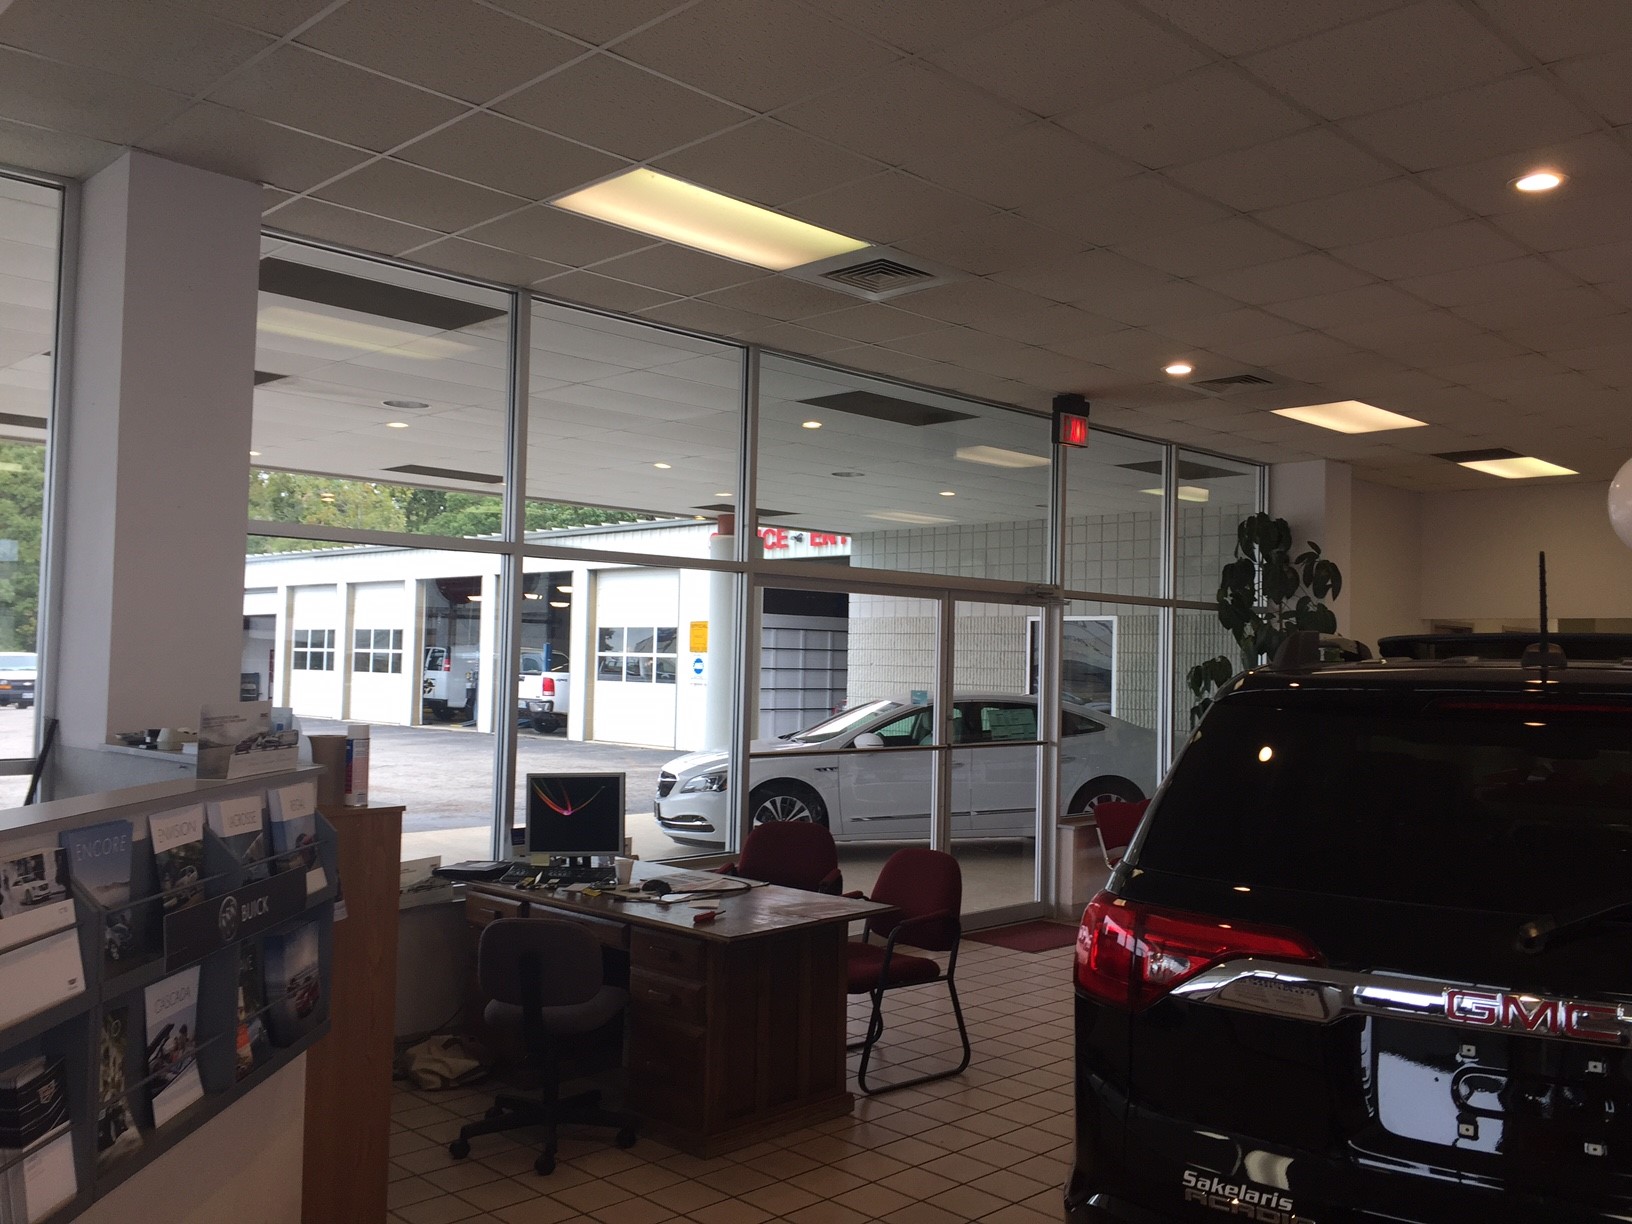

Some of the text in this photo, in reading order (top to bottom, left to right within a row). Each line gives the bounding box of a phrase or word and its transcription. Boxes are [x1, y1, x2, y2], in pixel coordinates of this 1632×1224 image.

[75, 834, 127, 862] ENCORE
[240, 895, 270, 923] BUICK
[1444, 988, 1621, 1043] GMC
[1182, 1169, 1294, 1212] Sakelaris
